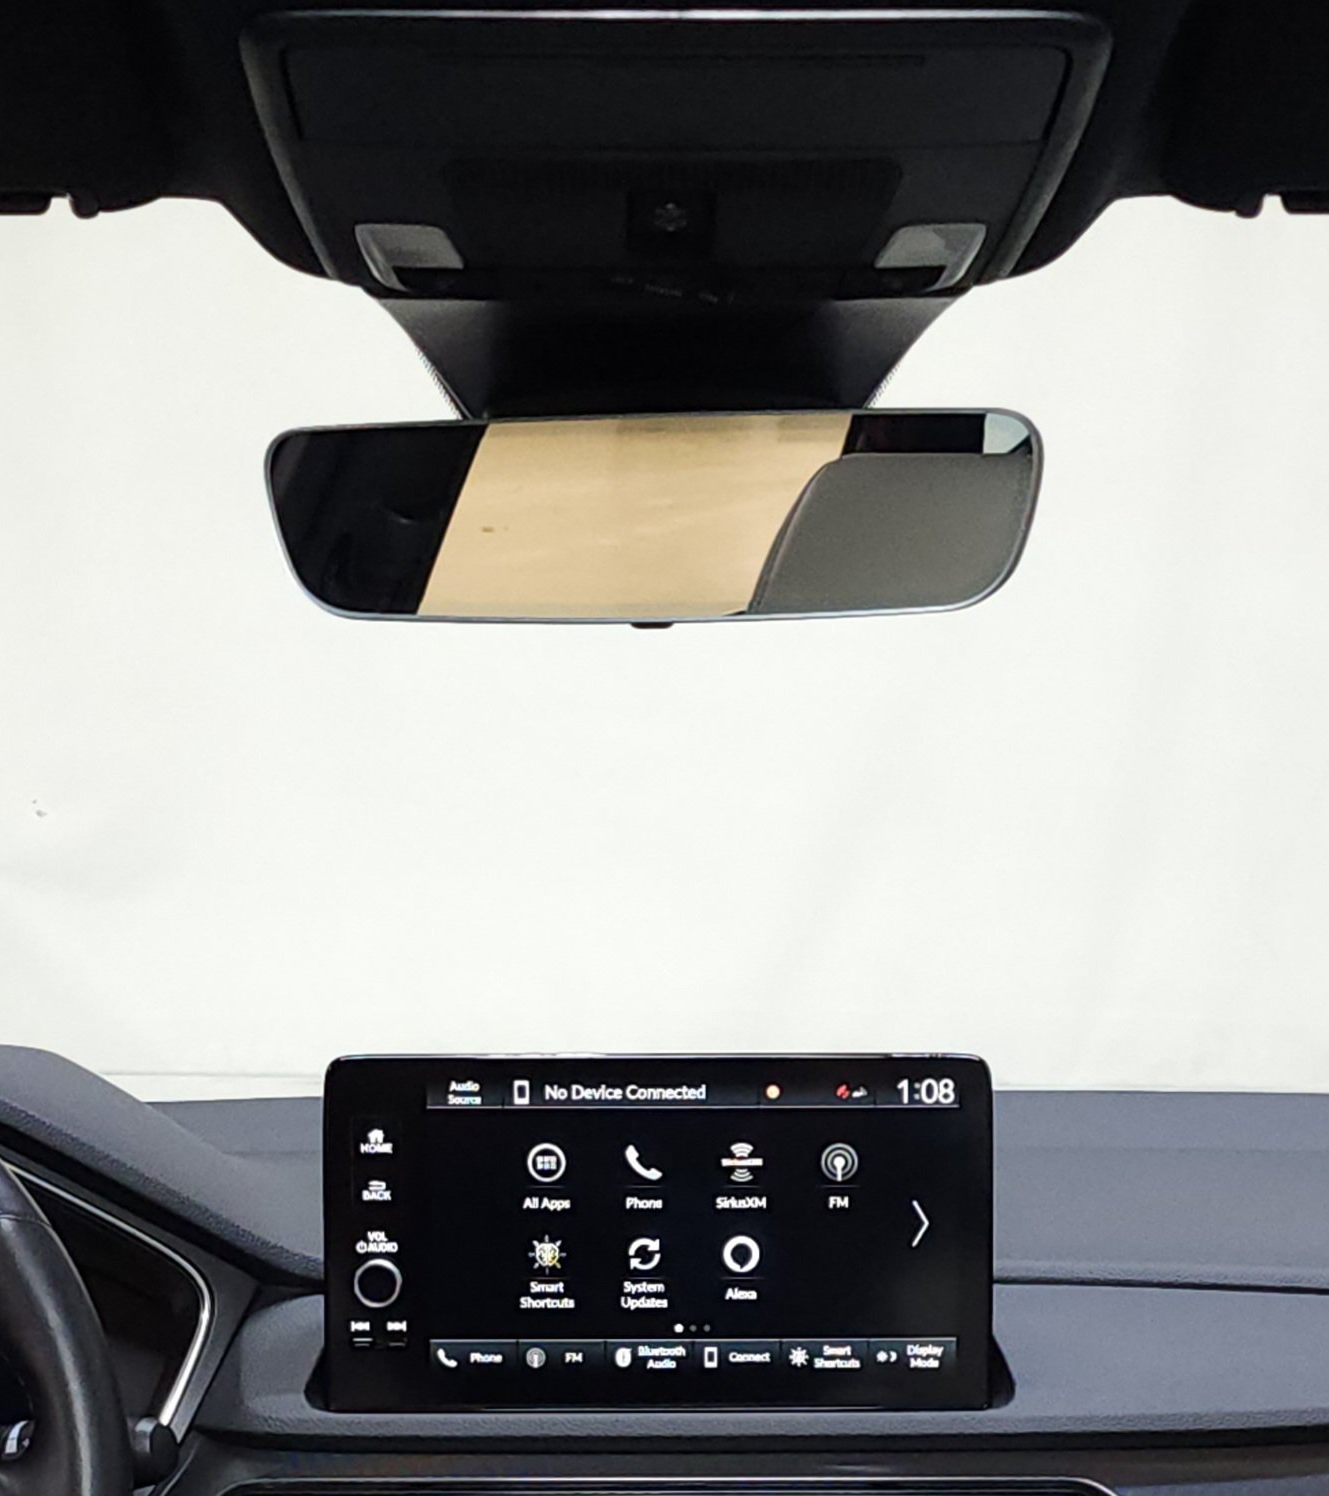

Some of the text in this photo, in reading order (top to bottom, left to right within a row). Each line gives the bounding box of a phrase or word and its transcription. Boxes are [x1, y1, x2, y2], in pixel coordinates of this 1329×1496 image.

[449, 1081, 480, 1092] Audio
[545, 1084, 706, 1100] No Device Connected
[897, 1078, 955, 1104] 1:08
[448, 1094, 482, 1105] Source
[360, 1143, 393, 1154] HOME
[362, 1190, 392, 1201] BACK
[523, 1197, 571, 1211] All Apps
[626, 1197, 663, 1209] Phone
[716, 1196, 767, 1209] SiriusXM
[829, 1196, 849, 1208] FM
[368, 1231, 388, 1241] VOL
[368, 1242, 399, 1253] AUDIO
[530, 1281, 564, 1293] Smart
[623, 1281, 665, 1294] System
[725, 1287, 757, 1300] Alexa
[520, 1297, 575, 1309] Shortcuts
[621, 1297, 668, 1310] Updates
[638, 1346, 686, 1357] Bluetooth
[823, 1345, 851, 1356] Smart
[906, 1344, 944, 1357] Display
[470, 1353, 503, 1363] Phone
[565, 1353, 583, 1363] FM
[729, 1352, 770, 1363] Connect
[910, 1358, 939, 1368] Mode
[646, 1358, 676, 1369] Audio
[814, 1358, 860, 1369] Shortcuts
